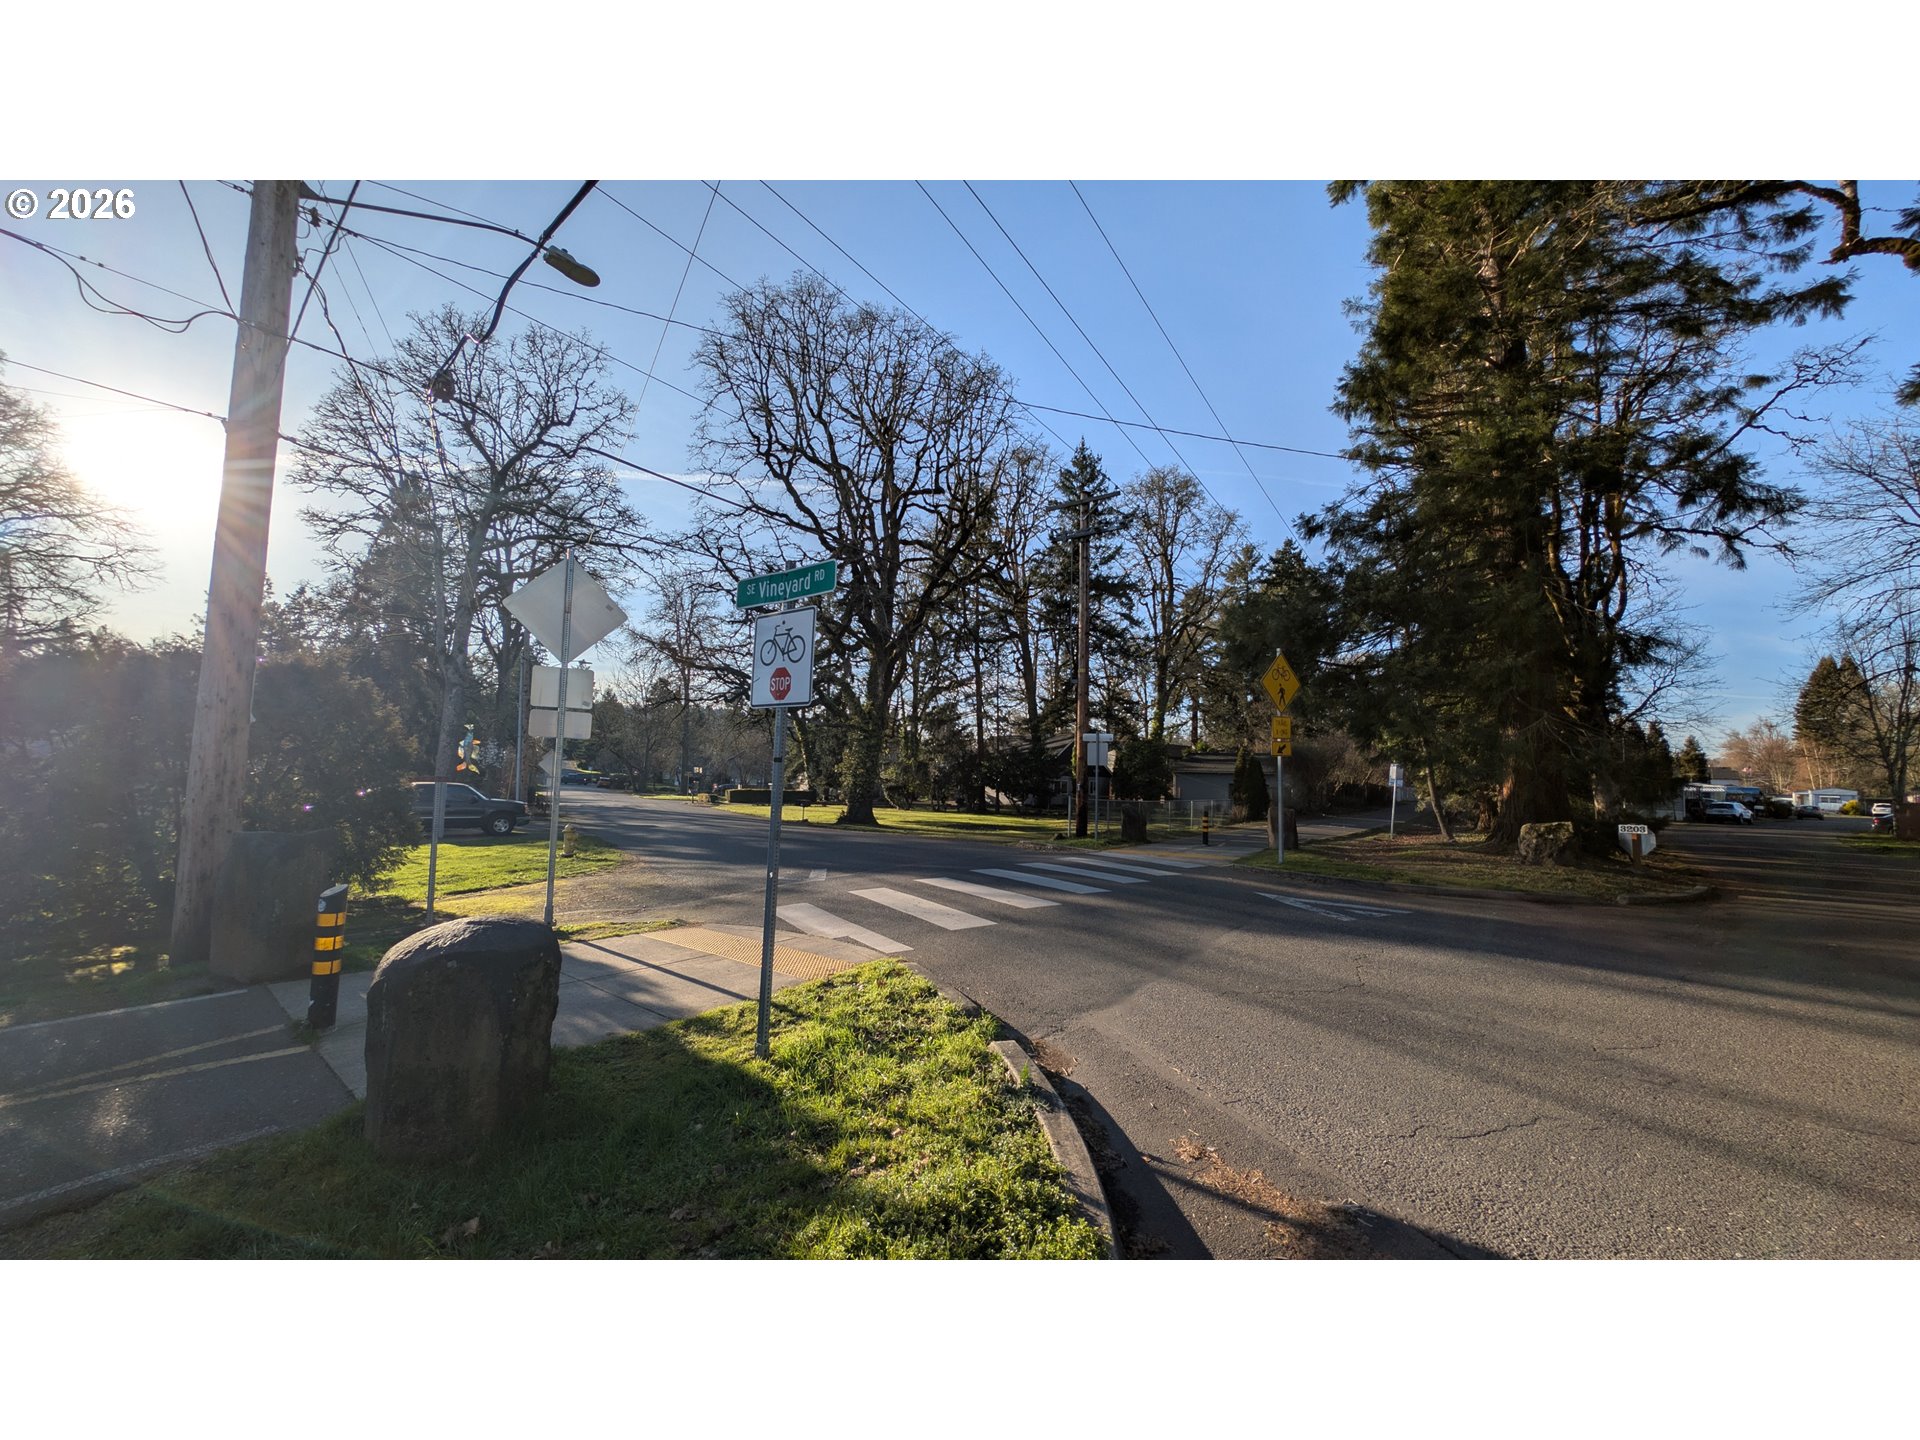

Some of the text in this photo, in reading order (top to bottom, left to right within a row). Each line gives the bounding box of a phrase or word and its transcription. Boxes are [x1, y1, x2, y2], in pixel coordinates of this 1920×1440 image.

[746, 568, 825, 599] SE Vineyard RD
[770, 676, 791, 692] STOP
